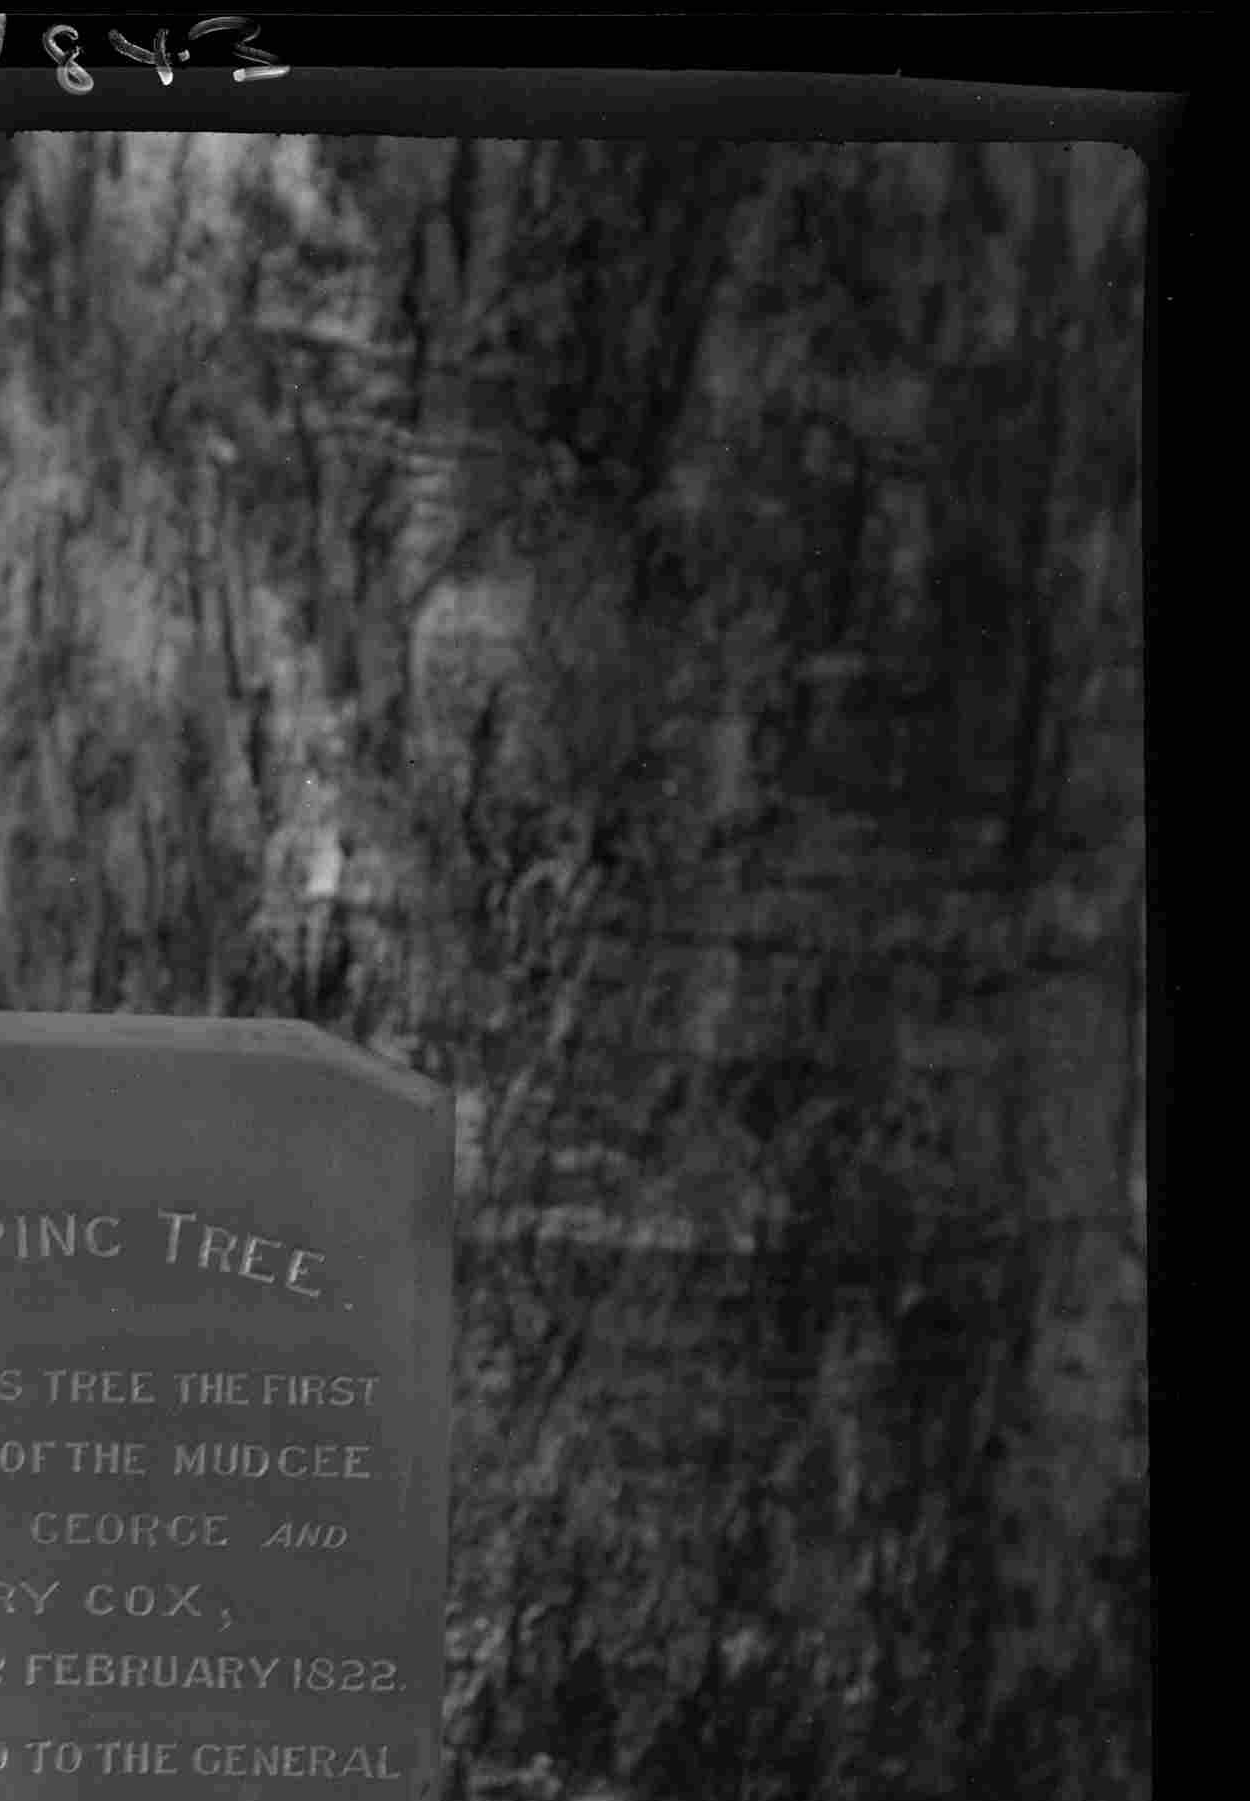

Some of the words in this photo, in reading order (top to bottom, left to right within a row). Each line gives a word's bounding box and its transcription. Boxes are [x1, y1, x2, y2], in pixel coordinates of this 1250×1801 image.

[47, 1368, 156, 1404] TREE
[174, 1371, 250, 1405] THE
[263, 1373, 380, 1407] FIRST
[0, 1440, 57, 1475] OF
[65, 1441, 146, 1475] THE
[260, 1521, 349, 1550] AND
[26, 1653, 281, 1689] FEBRUARY
[24, 1740, 84, 1775] TO
[95, 1741, 179, 1775] THE
